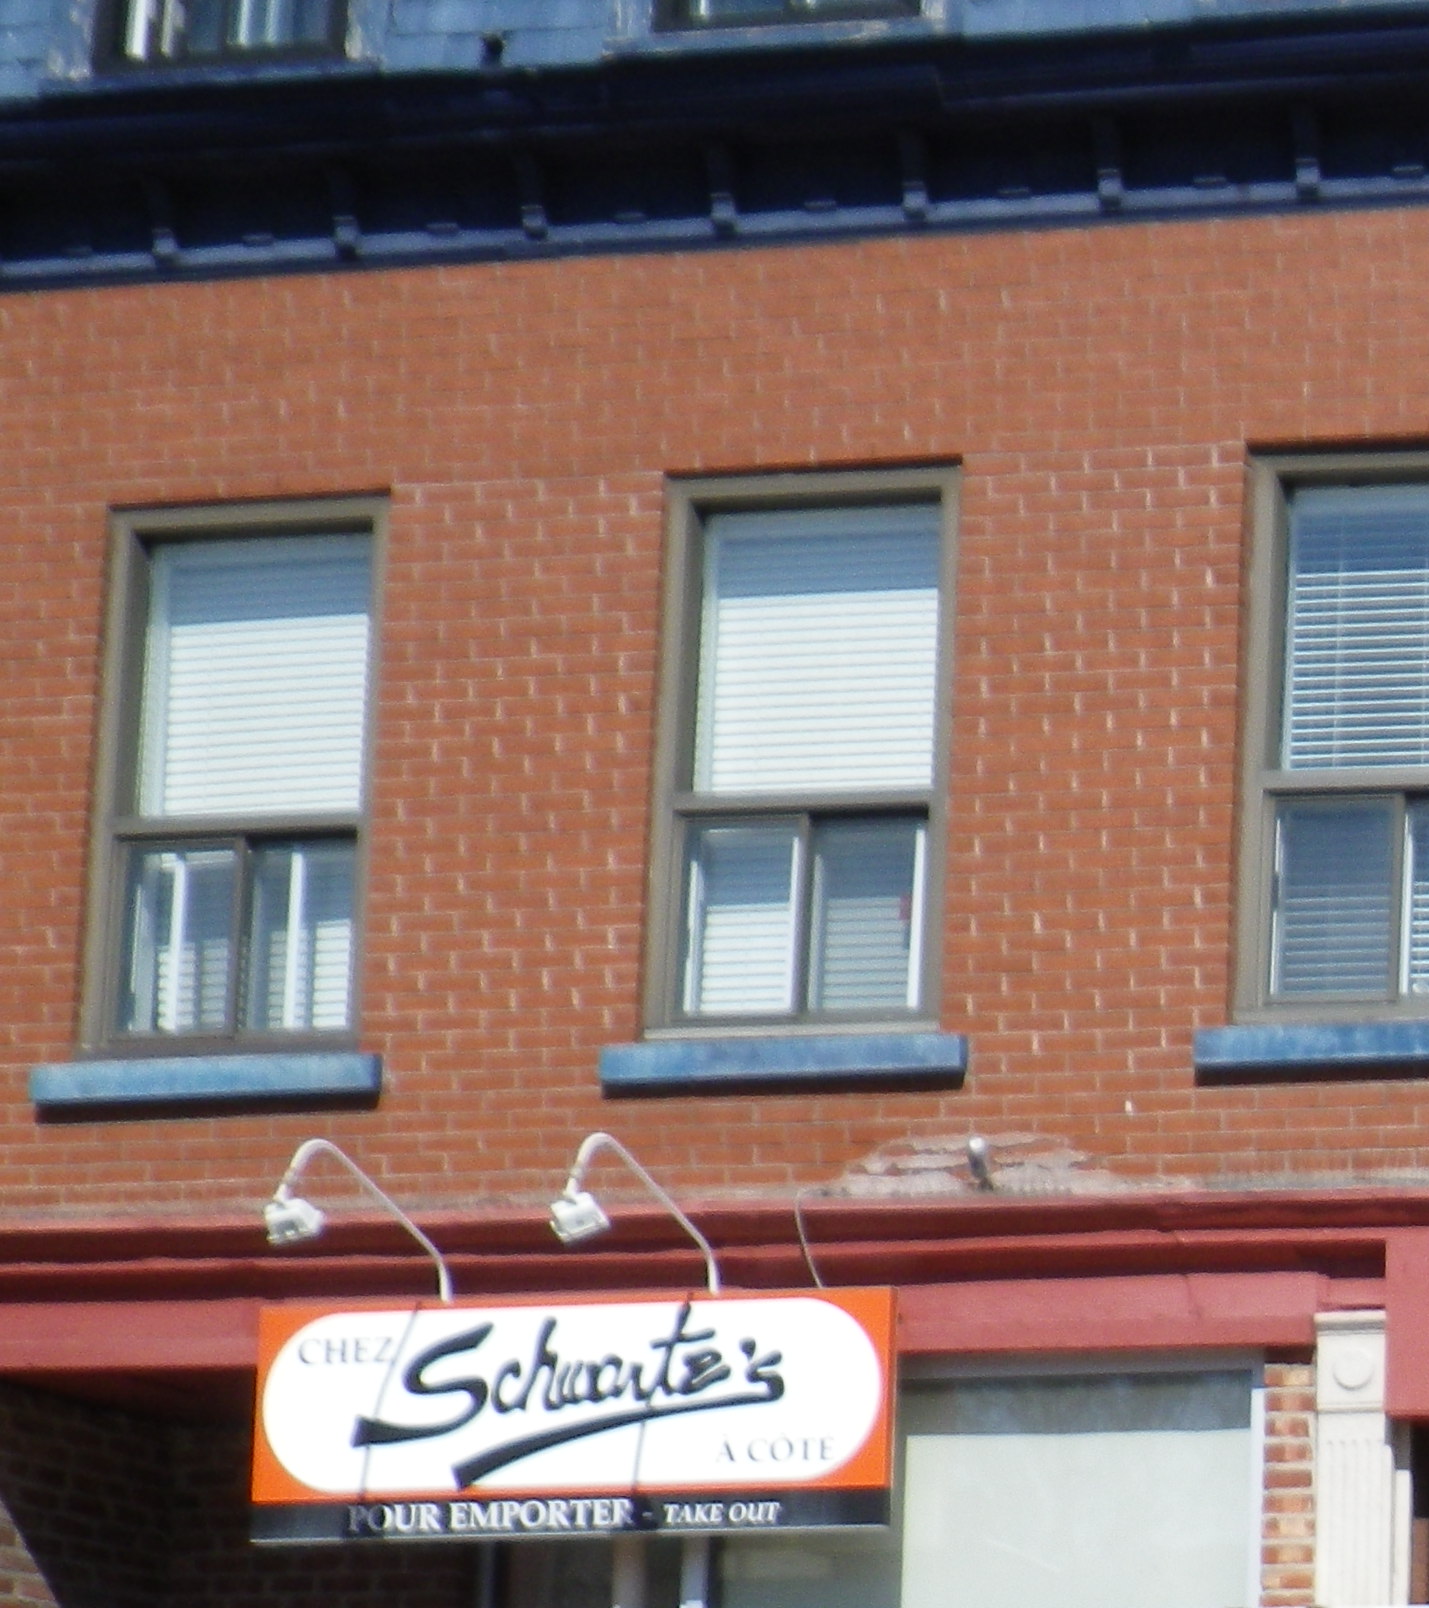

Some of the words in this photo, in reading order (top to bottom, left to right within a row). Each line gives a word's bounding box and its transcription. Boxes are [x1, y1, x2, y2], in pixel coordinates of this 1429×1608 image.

[298, 1335, 393, 1365] CHEZ
[350, 1301, 785, 1491] Schwartz's
[716, 1435, 737, 1463] À
[348, 1503, 441, 1533] POUR
[449, 1499, 633, 1530] EMPORTER
[664, 1503, 723, 1524] TAKE
[728, 1502, 781, 1523] OUT
